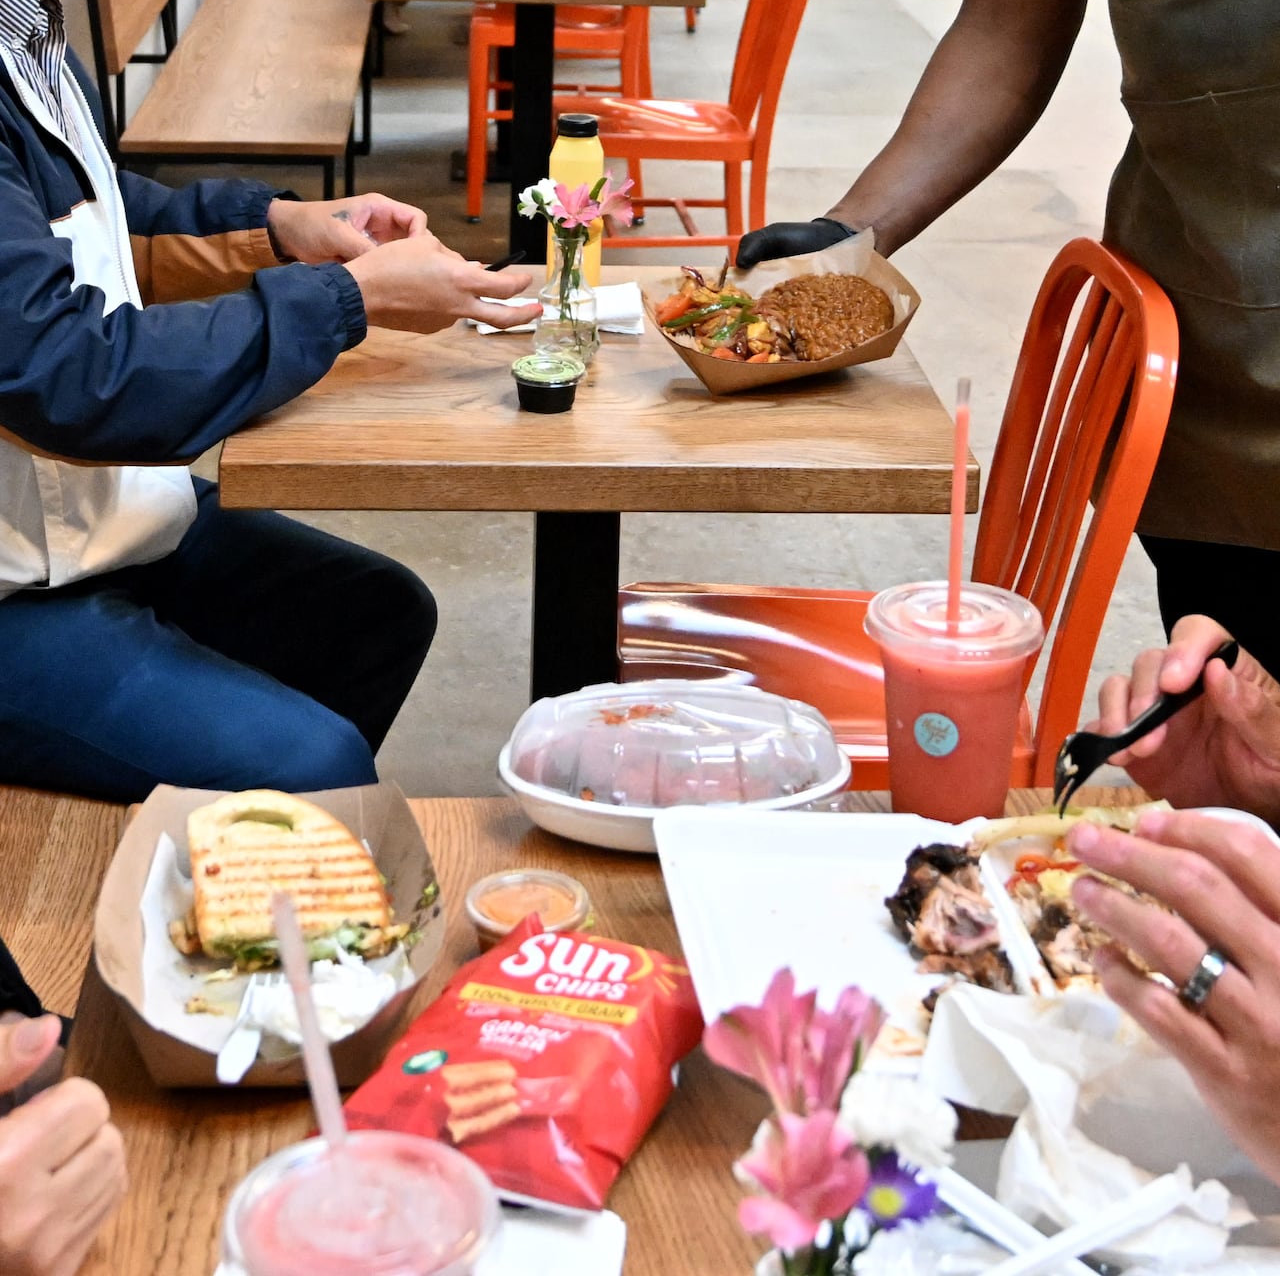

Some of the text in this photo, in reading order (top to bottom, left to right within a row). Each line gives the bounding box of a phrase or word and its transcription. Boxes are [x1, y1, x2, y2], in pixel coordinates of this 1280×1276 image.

[499, 932, 631, 981] Sun
[535, 973, 628, 1001] CHIPS
[576, 1002, 626, 1019] GRAIN
[480, 1018, 572, 1042] GARDEN
